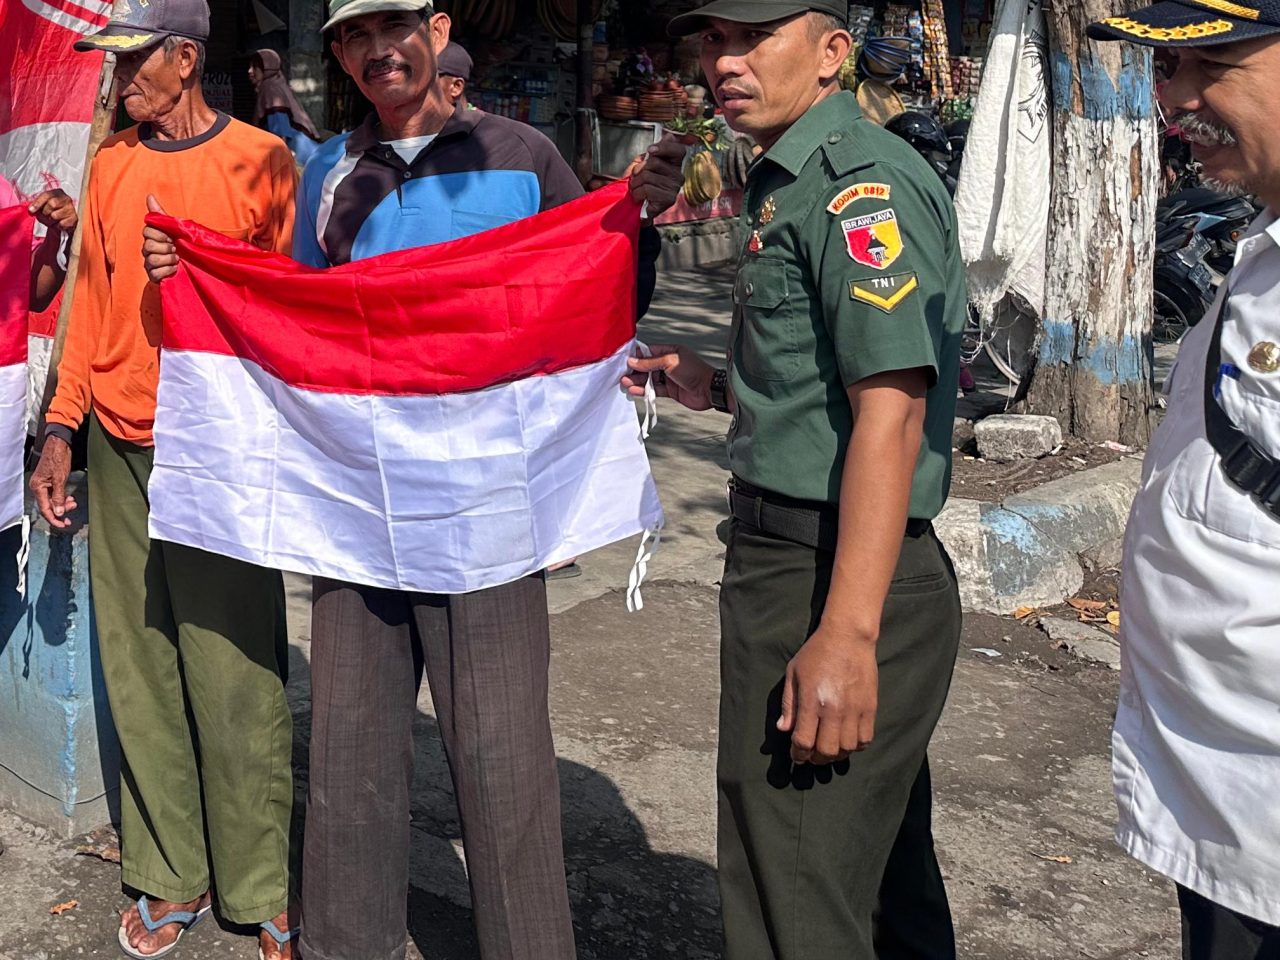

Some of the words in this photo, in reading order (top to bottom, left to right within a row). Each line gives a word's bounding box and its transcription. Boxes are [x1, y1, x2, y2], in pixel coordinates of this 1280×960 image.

[832, 189, 859, 211] KODIM
[863, 187, 885, 198] 0812
[845, 211, 894, 230] BRAWIJAYA
[872, 276, 896, 288] TNI
